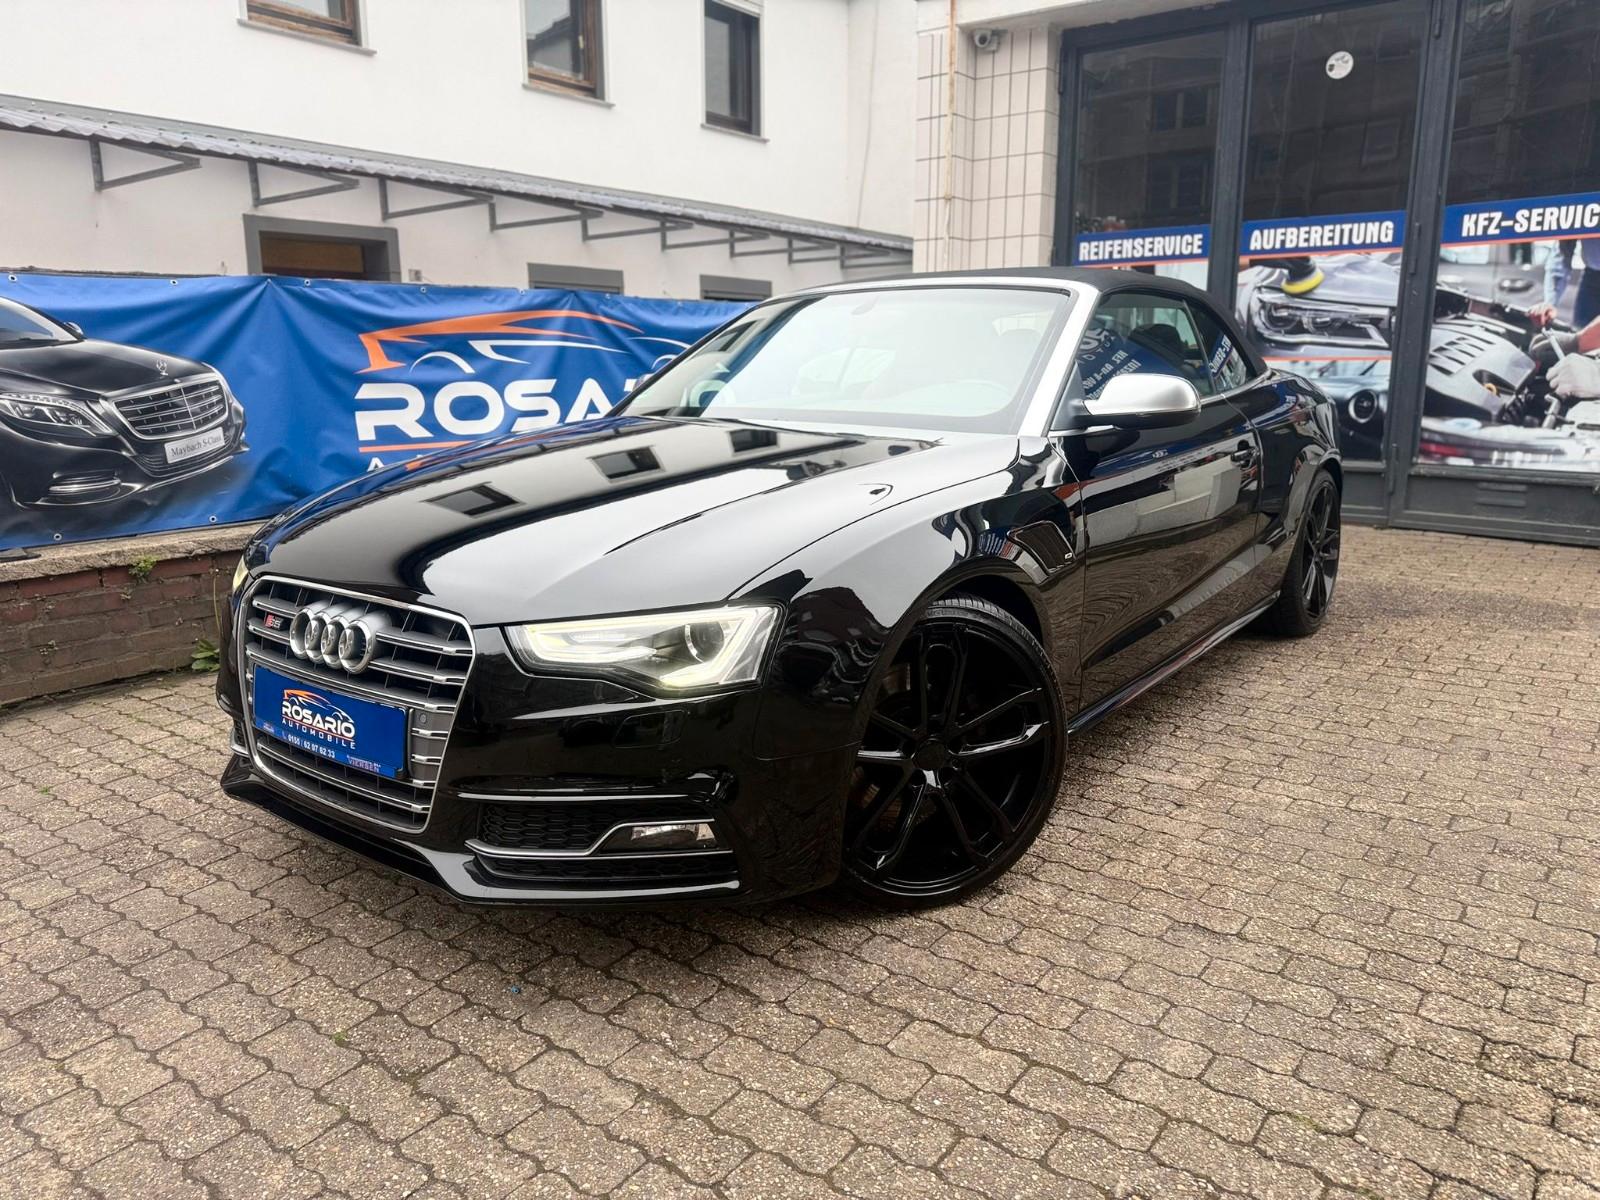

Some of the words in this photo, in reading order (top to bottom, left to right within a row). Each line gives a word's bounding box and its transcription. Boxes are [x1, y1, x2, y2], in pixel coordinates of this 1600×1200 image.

[1079, 234, 1203, 261] REIFENSERVICE
[1249, 221, 1394, 250] AUFBEREITUNG
[170, 442, 202, 457] Maybach
[282, 701, 355, 738] ROSARIO
[282, 719, 356, 750] AUTOMOBILE
